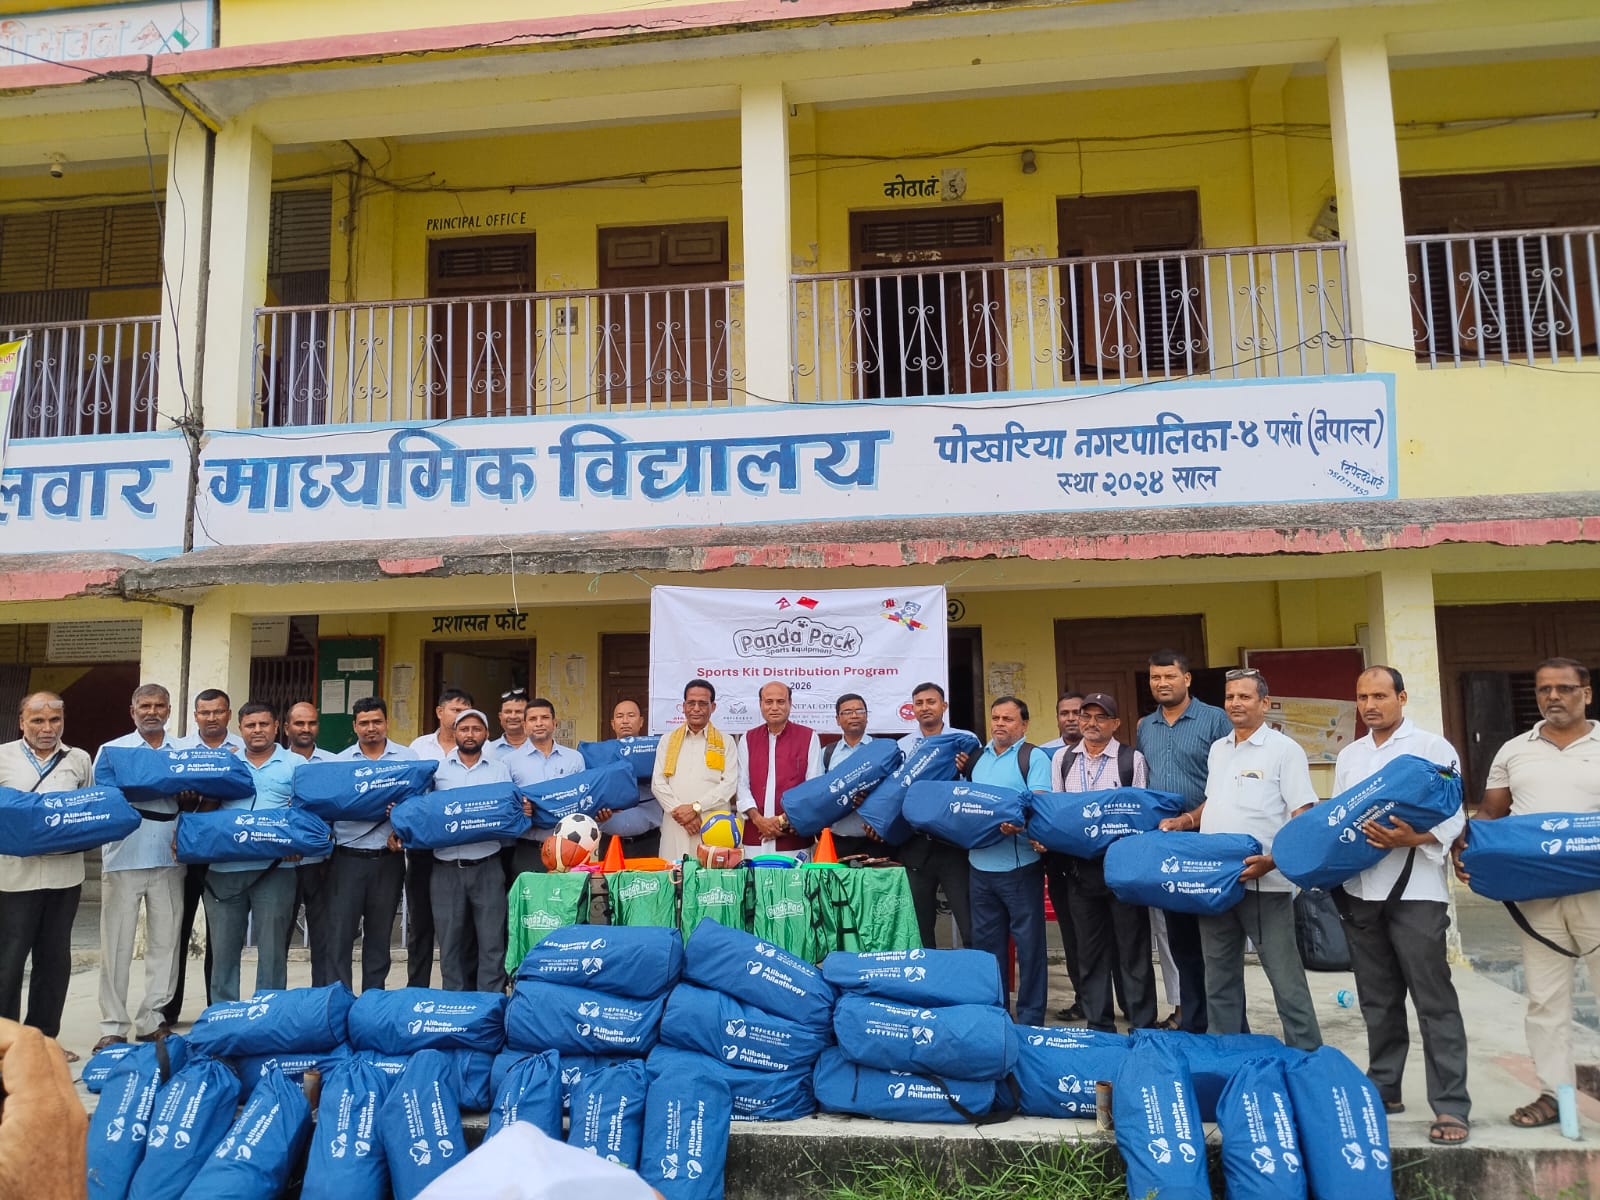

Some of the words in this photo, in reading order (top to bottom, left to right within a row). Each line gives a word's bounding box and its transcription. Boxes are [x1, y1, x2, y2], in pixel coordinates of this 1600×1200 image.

[426, 216, 482, 231] PRINCIPAL
[486, 212, 527, 226] OFFICE
[934, 421, 1067, 463] पोखरिया
[1308, 408, 1384, 456] (नेपाल)
[548, 423, 893, 501] विद्यालय
[1102, 471, 1164, 496] २०२४
[1172, 467, 1222, 492] साल
[432, 614, 490, 633] प्रशासन
[741, 627, 802, 651] Panda
[809, 628, 855, 650] Pack
[766, 647, 790, 655] Sports
[792, 646, 832, 655] Equipment
[697, 667, 739, 678] Sports
[743, 667, 760, 677] Kit
[763, 667, 840, 677] Distribution
[844, 666, 899, 678] Program
[790, 682, 812, 690] 2026
[371, 777, 396, 785] Alibaba
[63, 811, 92, 819] Alibaba
[63, 813, 111, 825] Philanthropy
[961, 807, 994, 815] Philanthropy
[1353, 805, 1379, 827] Alibaba
[460, 821, 501, 831] Philanthropy
[250, 836, 292, 844] Philanthropy
[1566, 836, 1600, 845] Alibab
[1177, 886, 1222, 895] Philanthropy
[762, 972, 807, 997] Philanthropy
[765, 966, 793, 983] Alibaba
[423, 1025, 468, 1033] Philanthropy
[593, 1026, 624, 1036] Alibaba
[593, 1032, 641, 1043] Philanthropy
[740, 1054, 790, 1071] Philanthropy
[741, 1048, 771, 1059] Alibaba
[143, 1068, 161, 1121] Philanthropy
[908, 1084, 941, 1092] Alibaba
[136, 1087, 149, 1120] Alibaba
[180, 1096, 195, 1128] Alibaba
[186, 1081, 208, 1129] Philanthropy
[1174, 1081, 1192, 1140] Philanthropy
[358, 1106, 367, 1138] Alibaba
[432, 1102, 443, 1136] Alibaba
[613, 1095, 628, 1152] Philanthropy
[1171, 1102, 1185, 1140] Alibaba
[1272, 1092, 1295, 1150] Philanthropy
[1360, 1086, 1382, 1146] Philanthropy
[1362, 1106, 1375, 1145] Alibaba
[245, 1115, 267, 1143] Alibaba
[608, 1115, 617, 1150] Alibaba
[688, 1120, 696, 1157] Alibaba
[695, 1100, 705, 1158] Philanthropy
[1274, 1112, 1288, 1149] Alibaba
